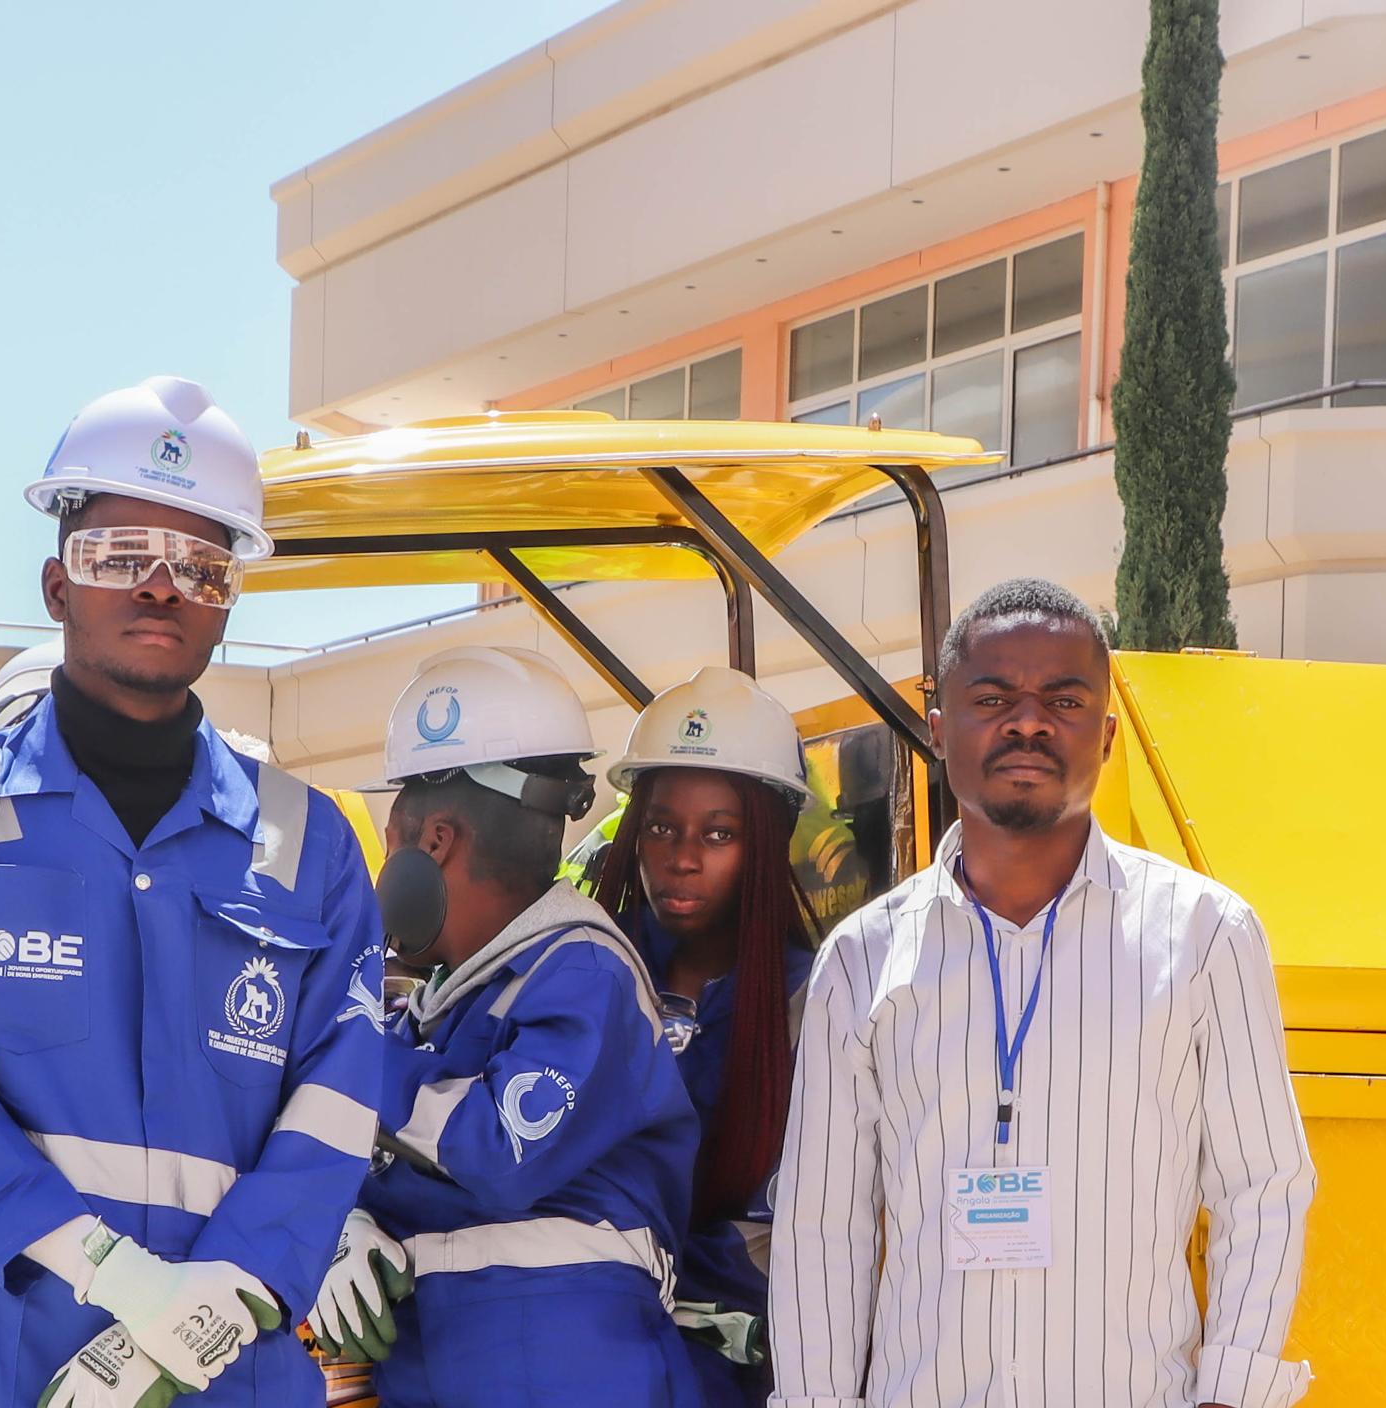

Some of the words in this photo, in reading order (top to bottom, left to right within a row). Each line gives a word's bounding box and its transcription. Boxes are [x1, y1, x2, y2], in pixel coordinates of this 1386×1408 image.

[426, 686, 459, 698] INEFOP
[544, 1067, 576, 1110] INEFOP
[957, 1172, 1042, 1194] JOBE
